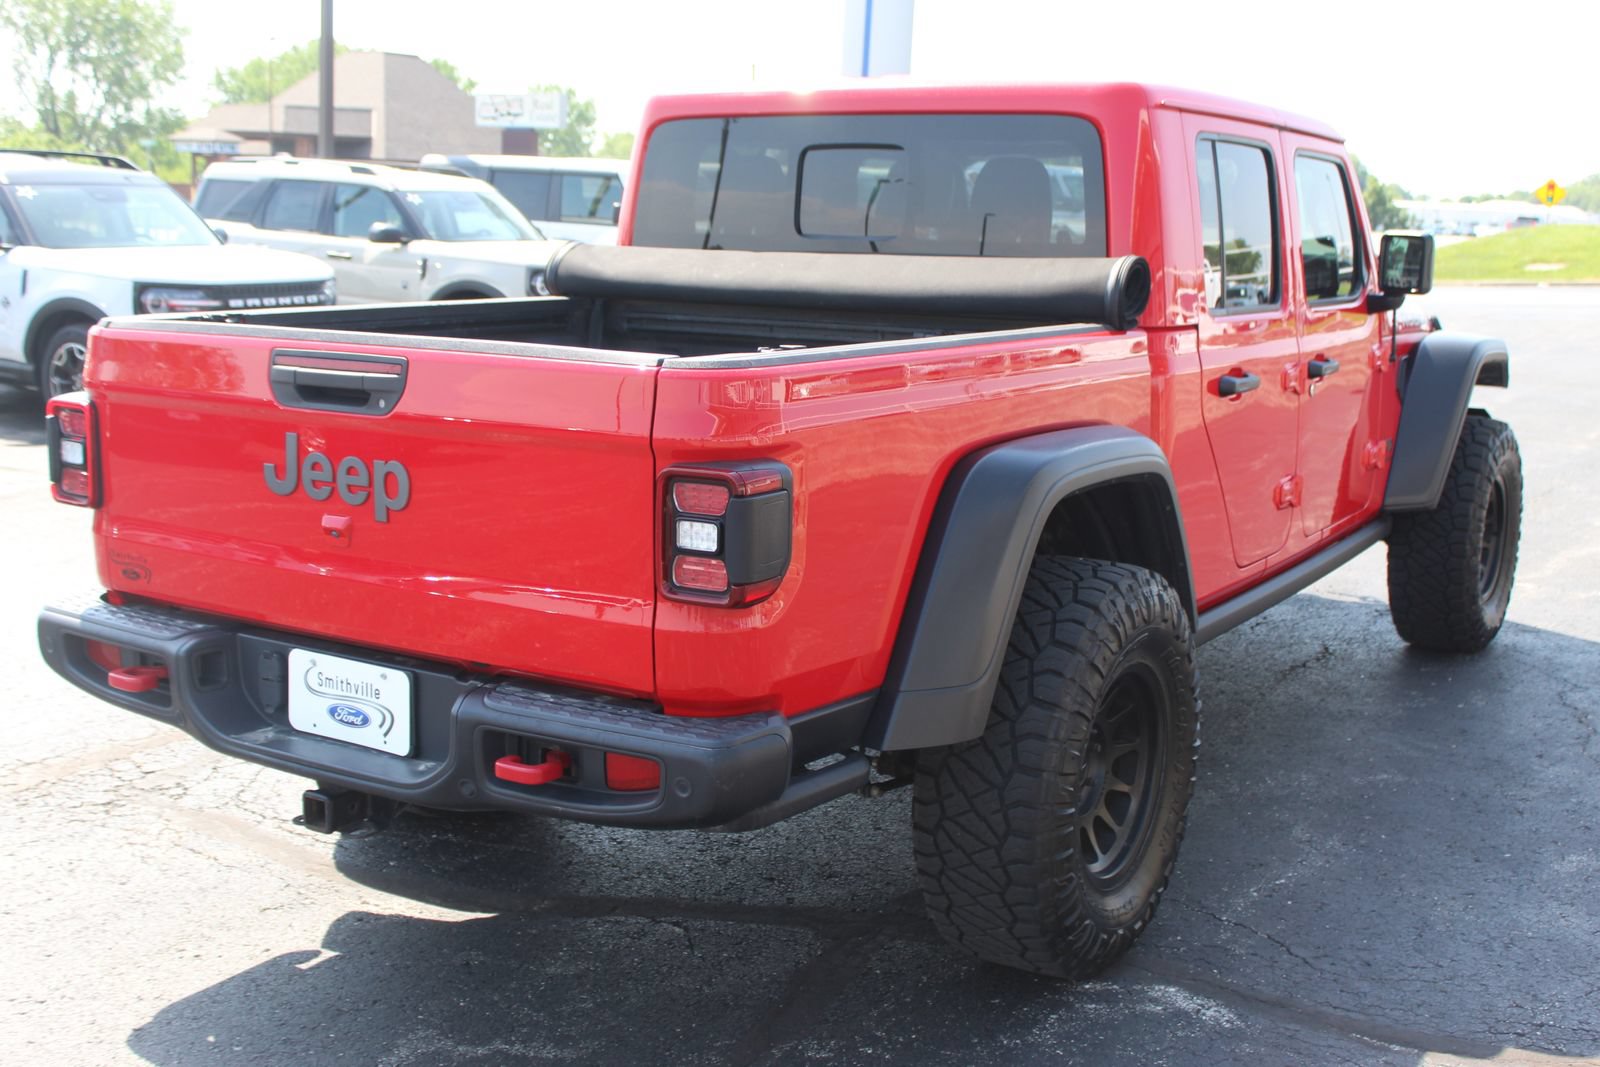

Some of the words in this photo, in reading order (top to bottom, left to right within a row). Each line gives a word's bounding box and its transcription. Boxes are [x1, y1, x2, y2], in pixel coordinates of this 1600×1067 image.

[228, 295, 319, 309] BRONCO
[263, 431, 411, 523] Jeep
[317, 671, 381, 700] Smithville
[333, 705, 363, 726] Ford
